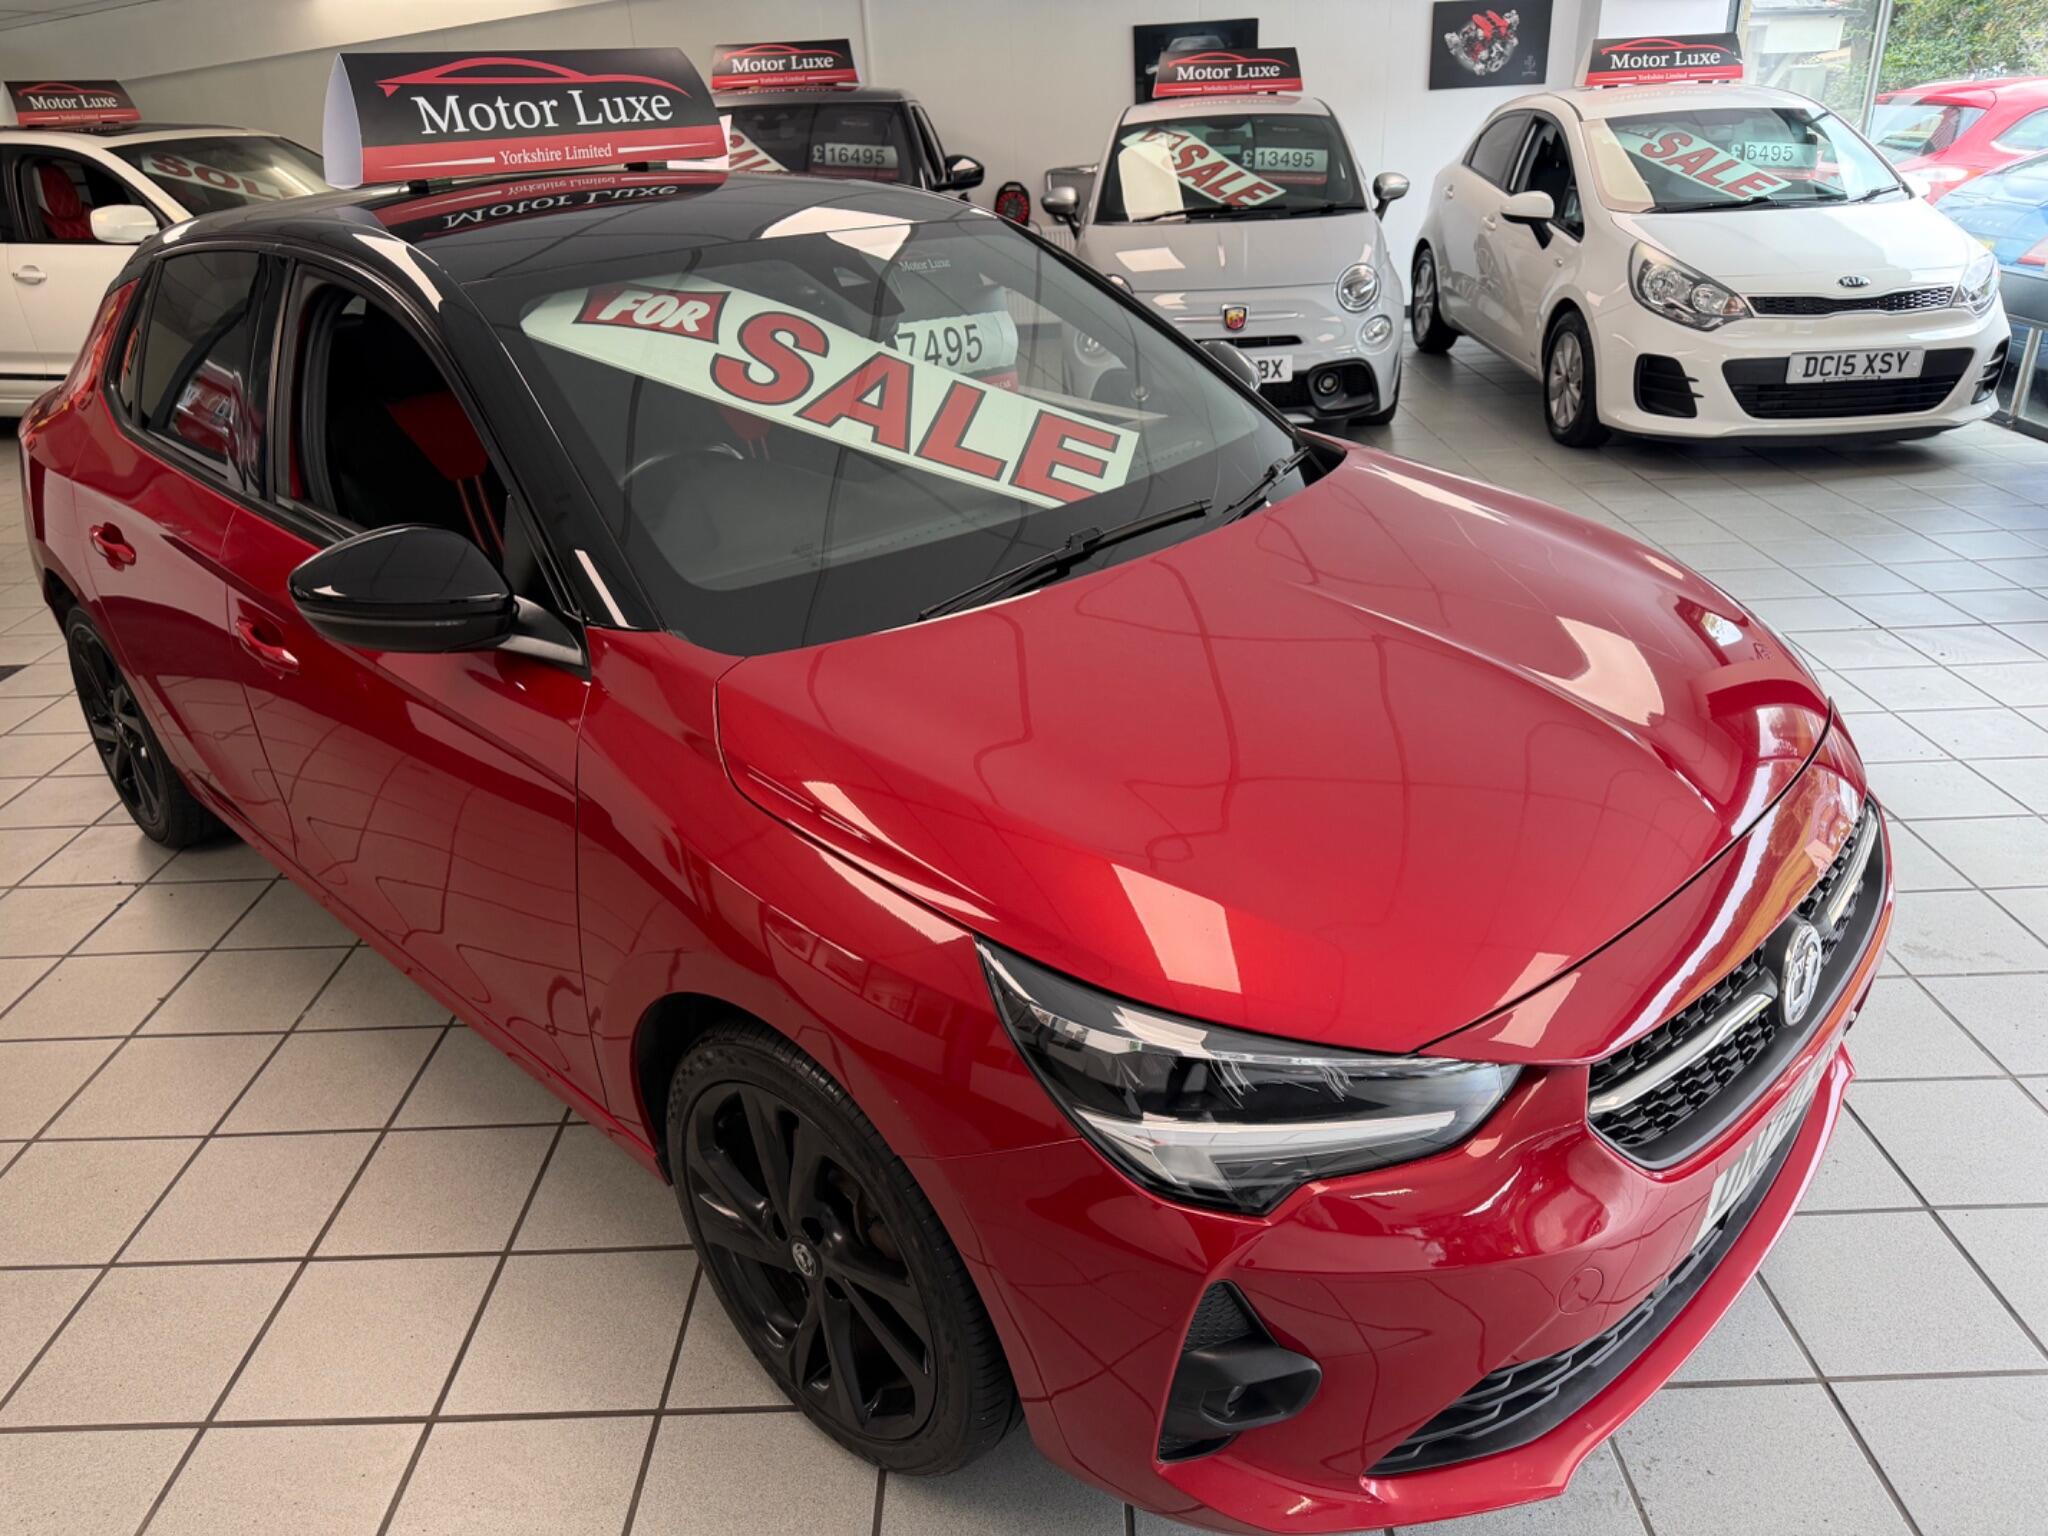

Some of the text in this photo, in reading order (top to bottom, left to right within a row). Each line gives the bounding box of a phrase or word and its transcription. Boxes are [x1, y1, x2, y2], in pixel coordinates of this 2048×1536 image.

[732, 55, 834, 73] Motor Luxe
[1610, 50, 1721, 70] Motor Luxe
[1176, 64, 1281, 81] Motor Luxe
[28, 94, 118, 110] Motor Luxe
[411, 89, 674, 135] Motor Luxe
[499, 143, 612, 165] Yorkshire Limited
[1639, 131, 1778, 199] SALE
[1173, 144, 1279, 208] SALE
[1839, 276, 1869, 286] KIA
[595, 290, 712, 333] FOR
[1802, 352, 1910, 378] DC15 XSY
[709, 310, 1122, 503] SALE
